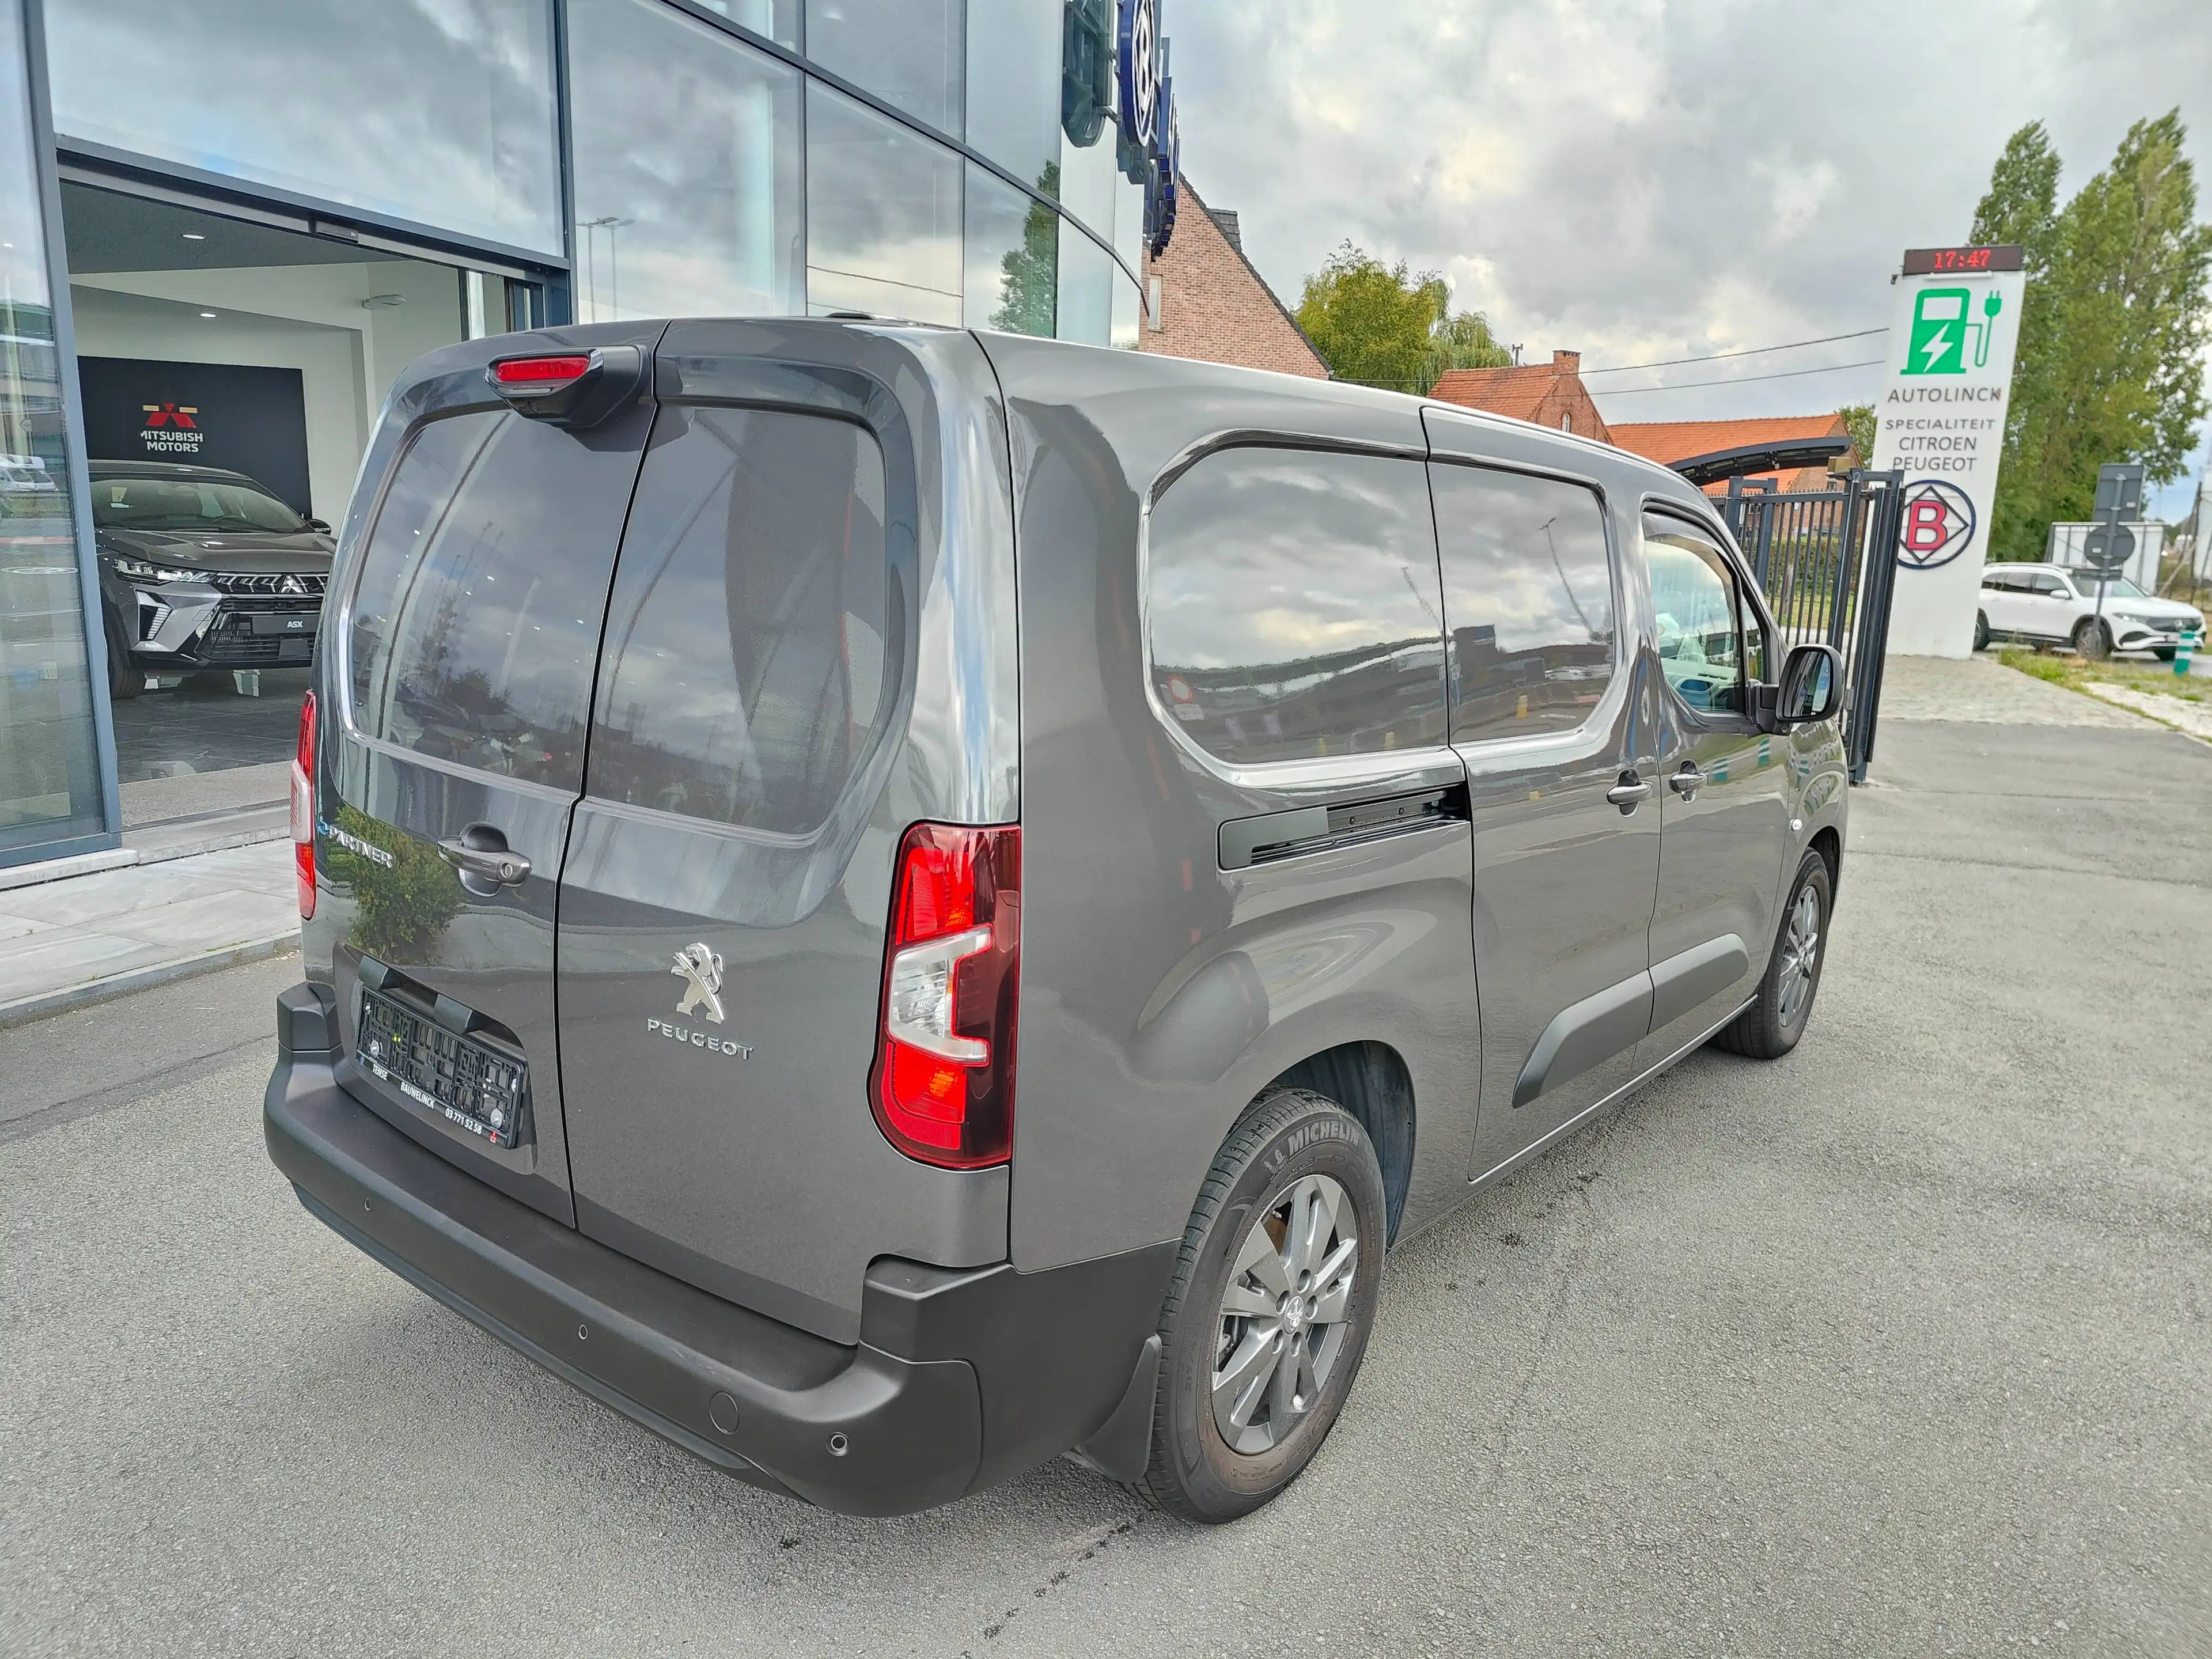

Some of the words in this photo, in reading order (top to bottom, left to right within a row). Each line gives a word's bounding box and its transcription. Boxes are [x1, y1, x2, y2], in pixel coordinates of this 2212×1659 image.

[1934, 249, 1991, 268] 17:47
[1887, 388, 2001, 403] AUTOLINCK
[1885, 419, 1995, 430] SPECIALITEIT
[146, 441, 199, 453] MOTORS
[1899, 437, 1977, 450] CITROEN
[1892, 457, 1977, 471] PEUGEOT
[1906, 500, 1948, 550] B
[329, 825, 393, 868] PARTNER
[647, 1017, 755, 1060] PEUGEOT
[372, 1063, 388, 1081] TEMSE
[400, 1081, 435, 1109] BAUWELINCK
[445, 1108, 454, 1119] 03
[453, 1112, 464, 1126] 771
[464, 1118, 474, 1131] 52
[473, 1123, 483, 1135] 58
[1287, 1120, 1359, 1156] MICHELIN
